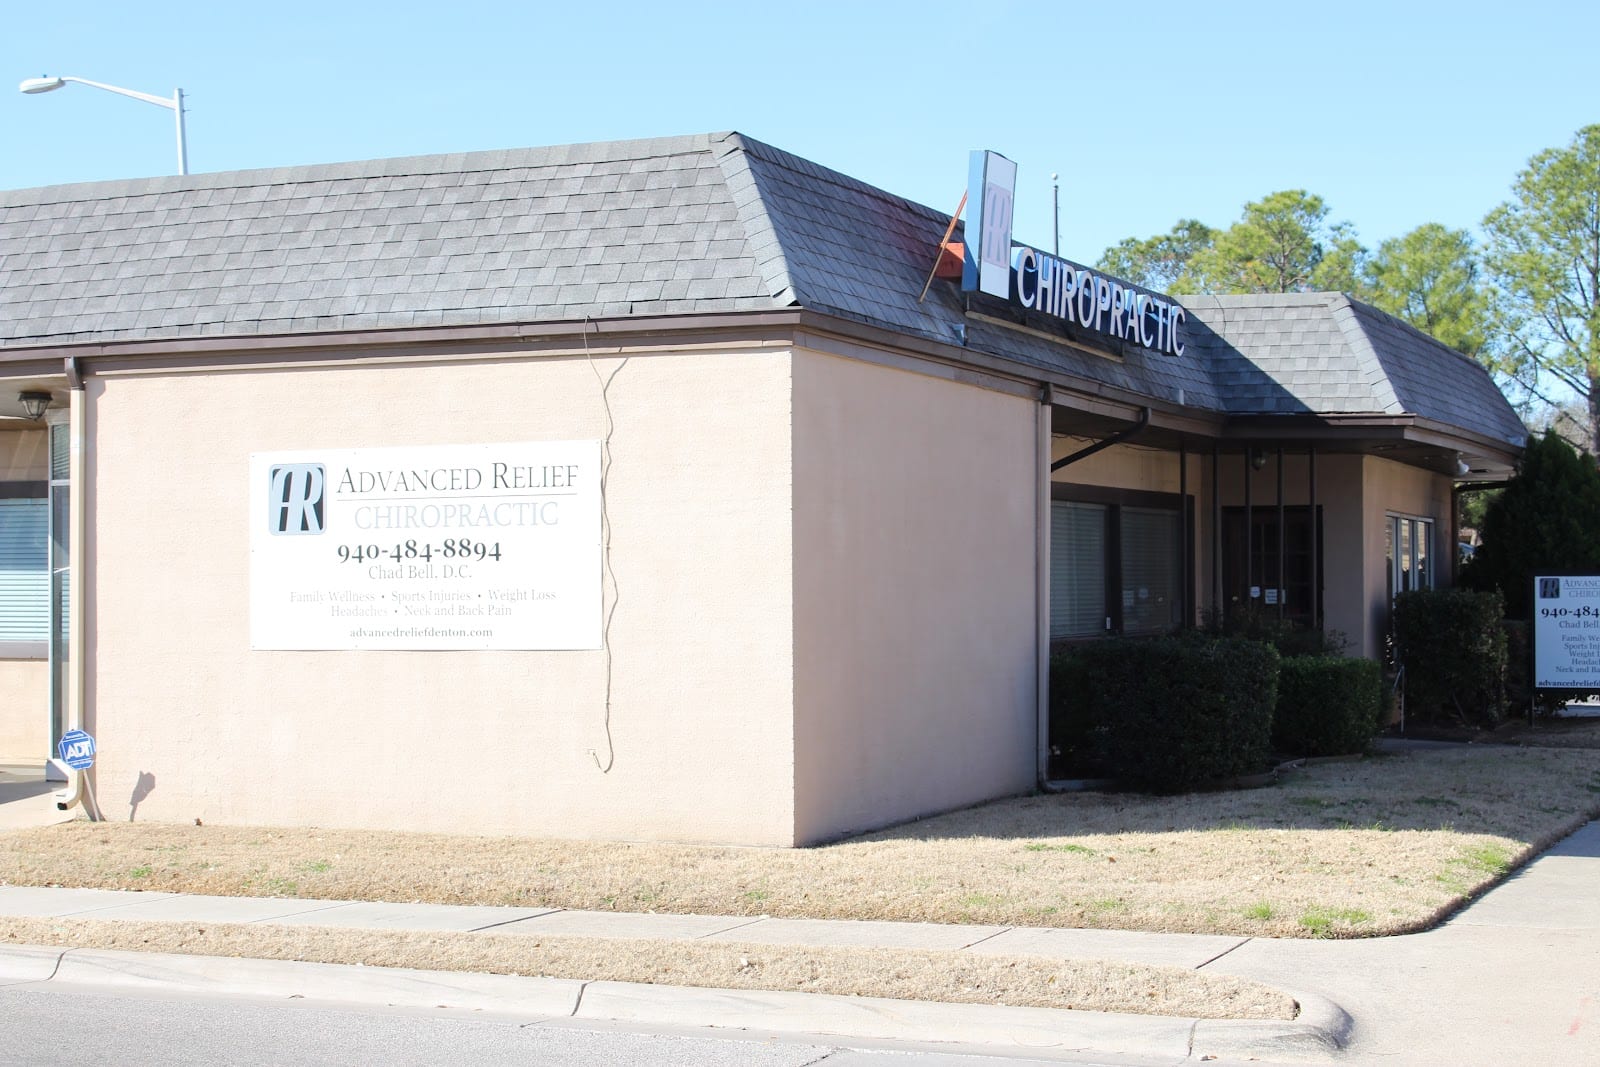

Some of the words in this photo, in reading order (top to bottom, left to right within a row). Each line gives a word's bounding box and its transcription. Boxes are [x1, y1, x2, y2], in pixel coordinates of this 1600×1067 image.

[1017, 246, 1186, 358] CHIROPRACTIC
[336, 466, 482, 493] ADVANCED
[491, 461, 579, 489] RELIEF
[354, 501, 559, 530] CHIROPRACTIC
[337, 538, 502, 564] 940-484-8894
[368, 565, 403, 580] Chad
[443, 564, 473, 579] D.C.
[289, 589, 325, 604] Family
[328, 589, 376, 603] Wellness
[391, 590, 426, 605] Sports
[429, 589, 471, 604] Injuries
[488, 587, 528, 604] Weight
[531, 588, 557, 601] Loss
[331, 604, 388, 617] Headaches
[404, 604, 431, 617] Neck
[434, 604, 454, 616] and
[458, 604, 484, 616] Back
[488, 604, 512, 616] Pain
[350, 627, 493, 638] advancedreliefdenton.com
[1558, 620, 1580, 629] Chad
[1561, 634, 1586, 643] Family
[1564, 643, 1588, 652] Sports
[1569, 650, 1594, 658] Weight
[66, 742, 91, 759] ADT
